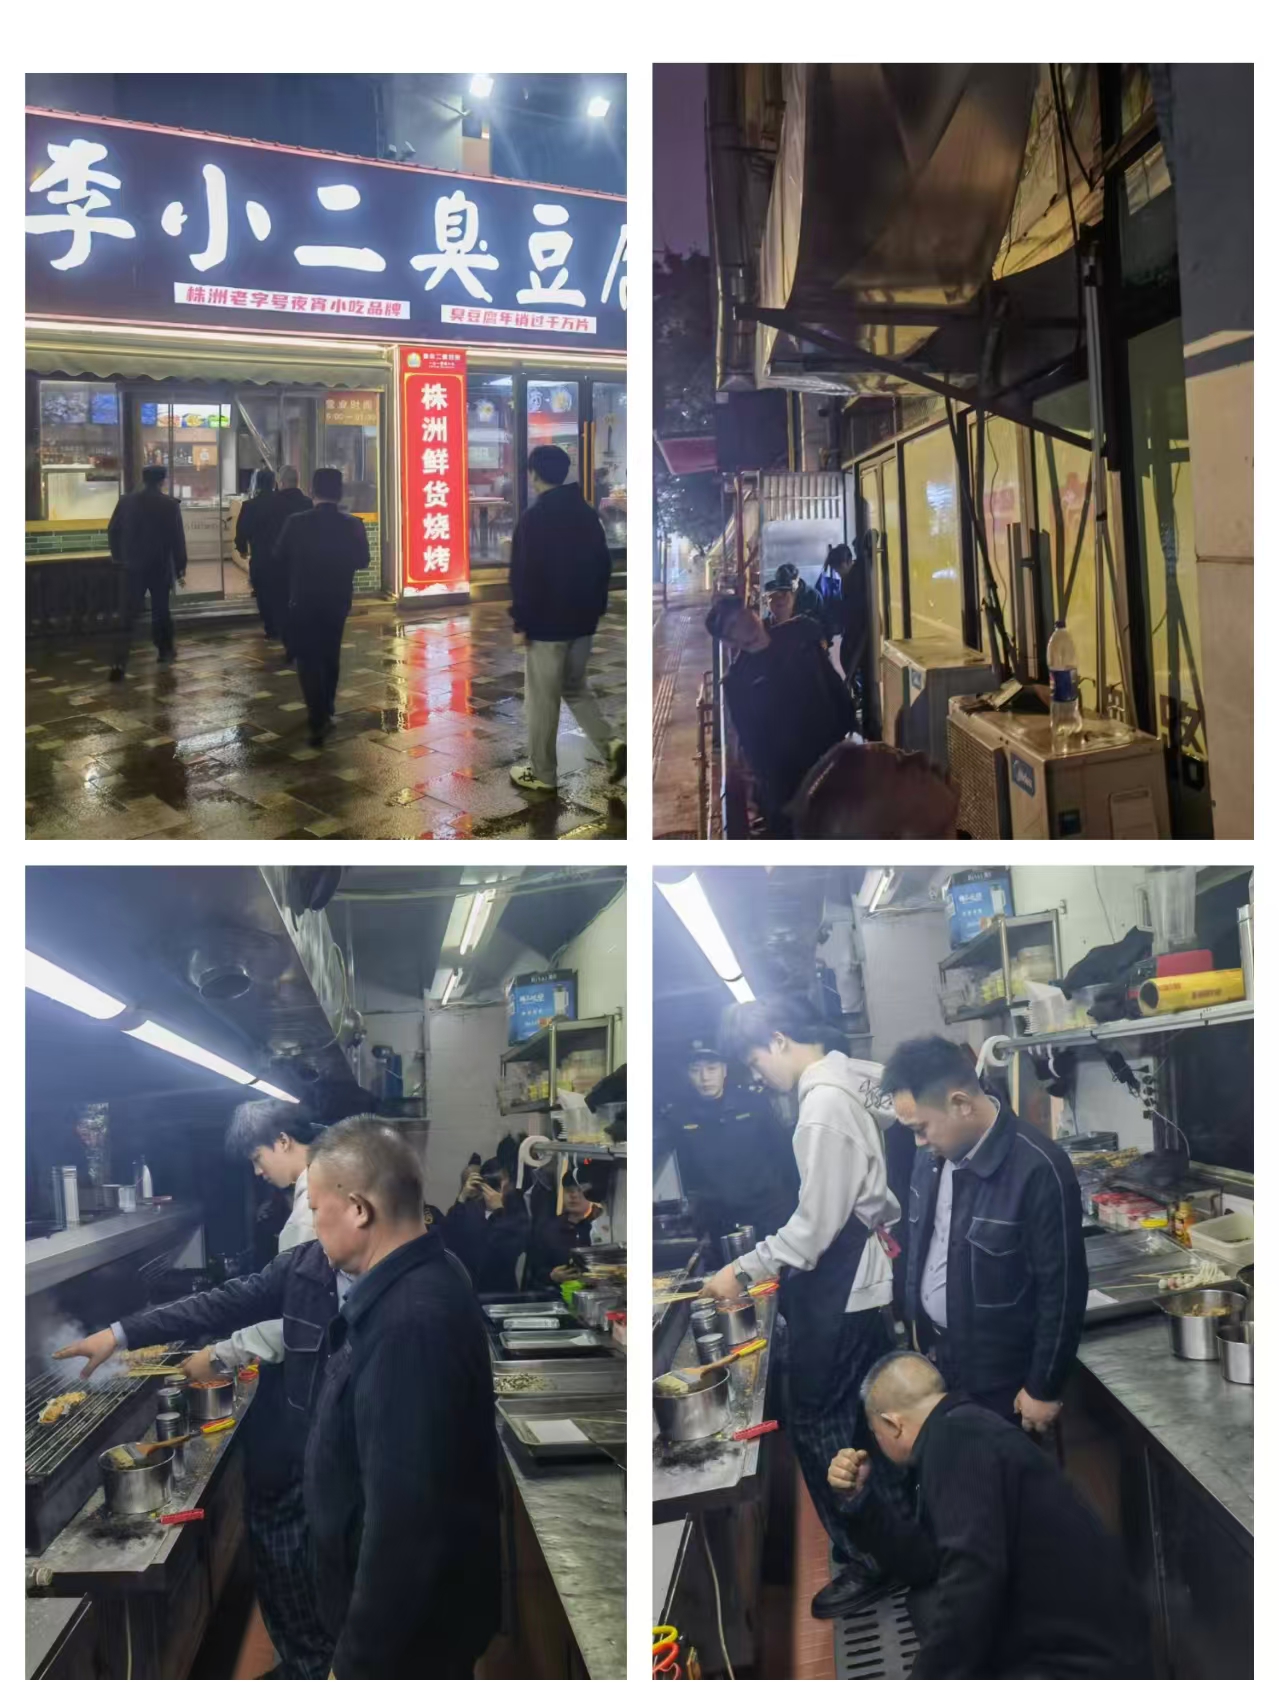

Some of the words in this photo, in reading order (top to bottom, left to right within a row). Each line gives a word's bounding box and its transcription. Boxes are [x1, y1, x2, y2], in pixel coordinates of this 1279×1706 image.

[25, 138, 627, 311] 李小二臭豆
[186, 286, 402, 317] 株洲老字号夜宵小吃品牌
[450, 307, 589, 331] 臭豆腐年销过千万片
[420, 382, 451, 573] 株洲鲜货烧烤
